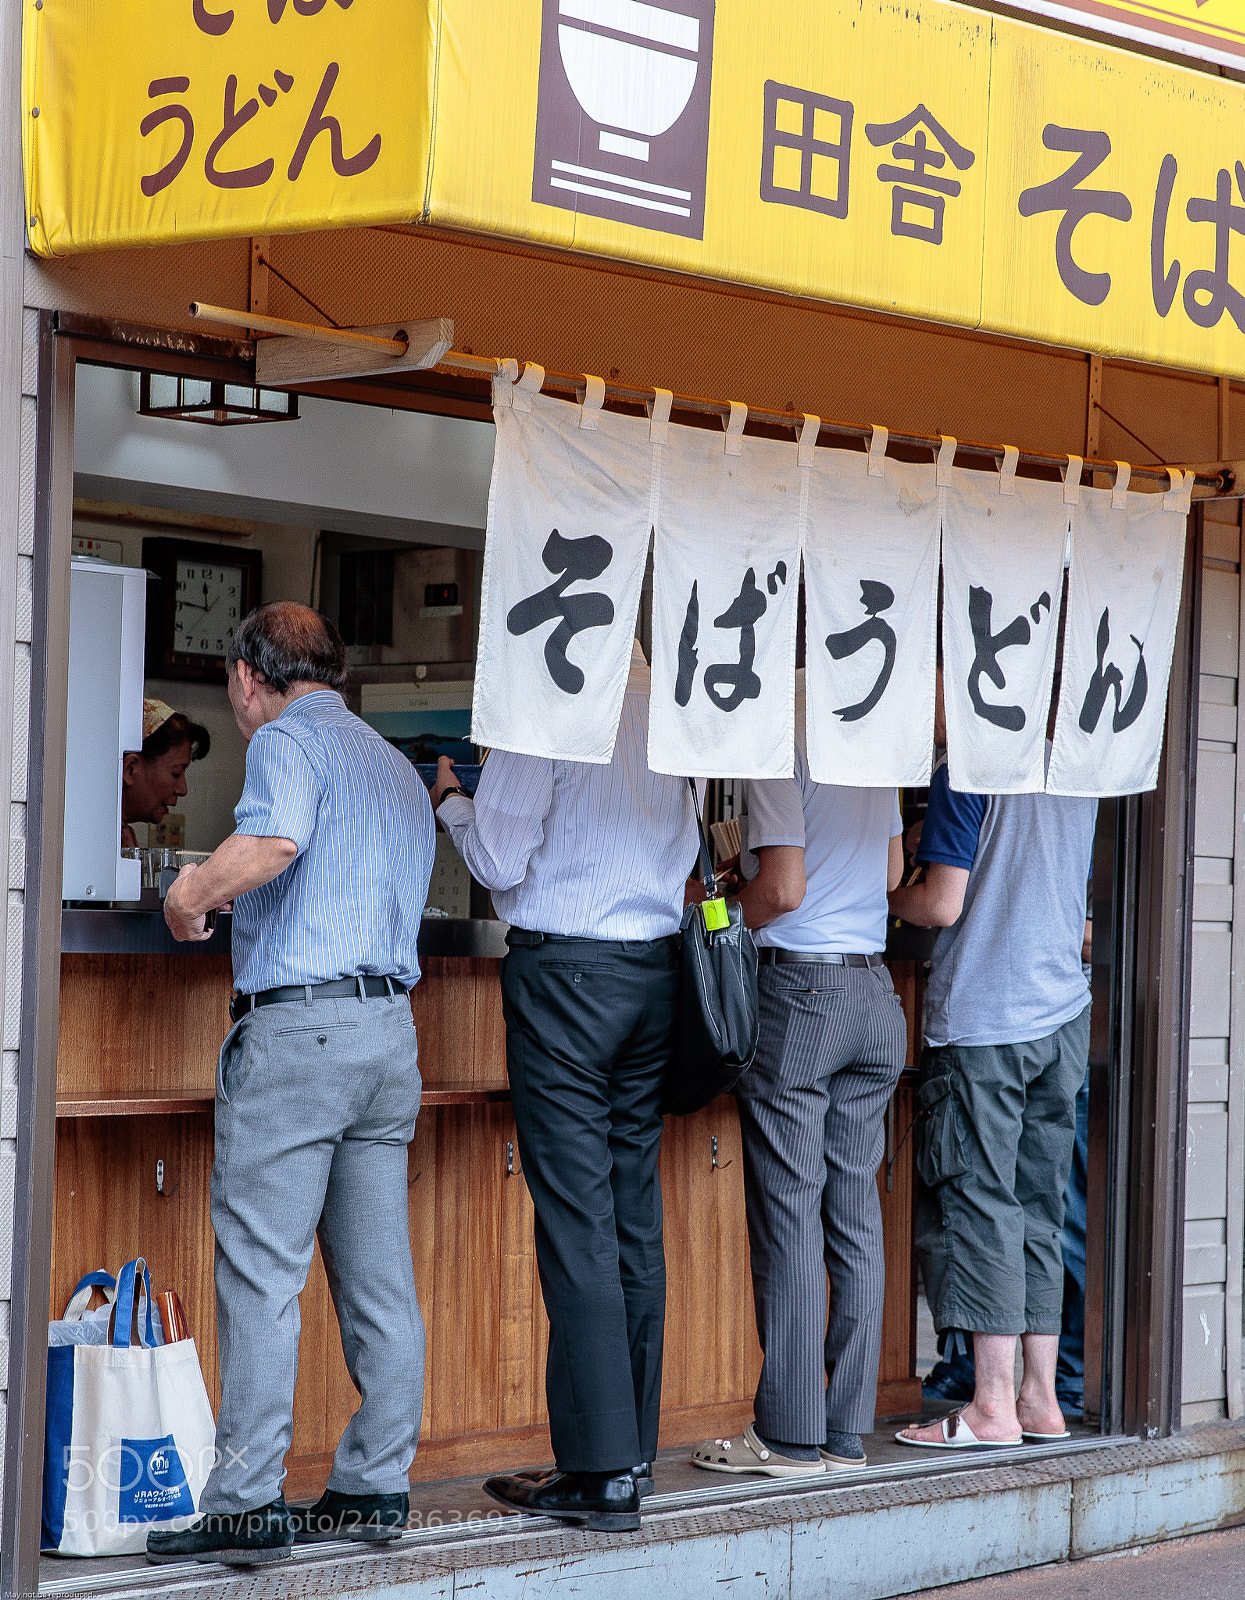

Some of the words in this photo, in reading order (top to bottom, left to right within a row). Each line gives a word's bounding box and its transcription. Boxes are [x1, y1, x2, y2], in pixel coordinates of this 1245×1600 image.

[140, 61, 382, 197] うどん
[187, 569, 195, 579] 11
[201, 568, 212, 580] 12
[227, 586, 236, 597] 2
[228, 607, 236, 617] 3
[226, 627, 234, 638] 4
[506, 528, 1149, 734] そばうどん
[185, 636, 193, 646] 7
[216, 639, 223, 650] 5
